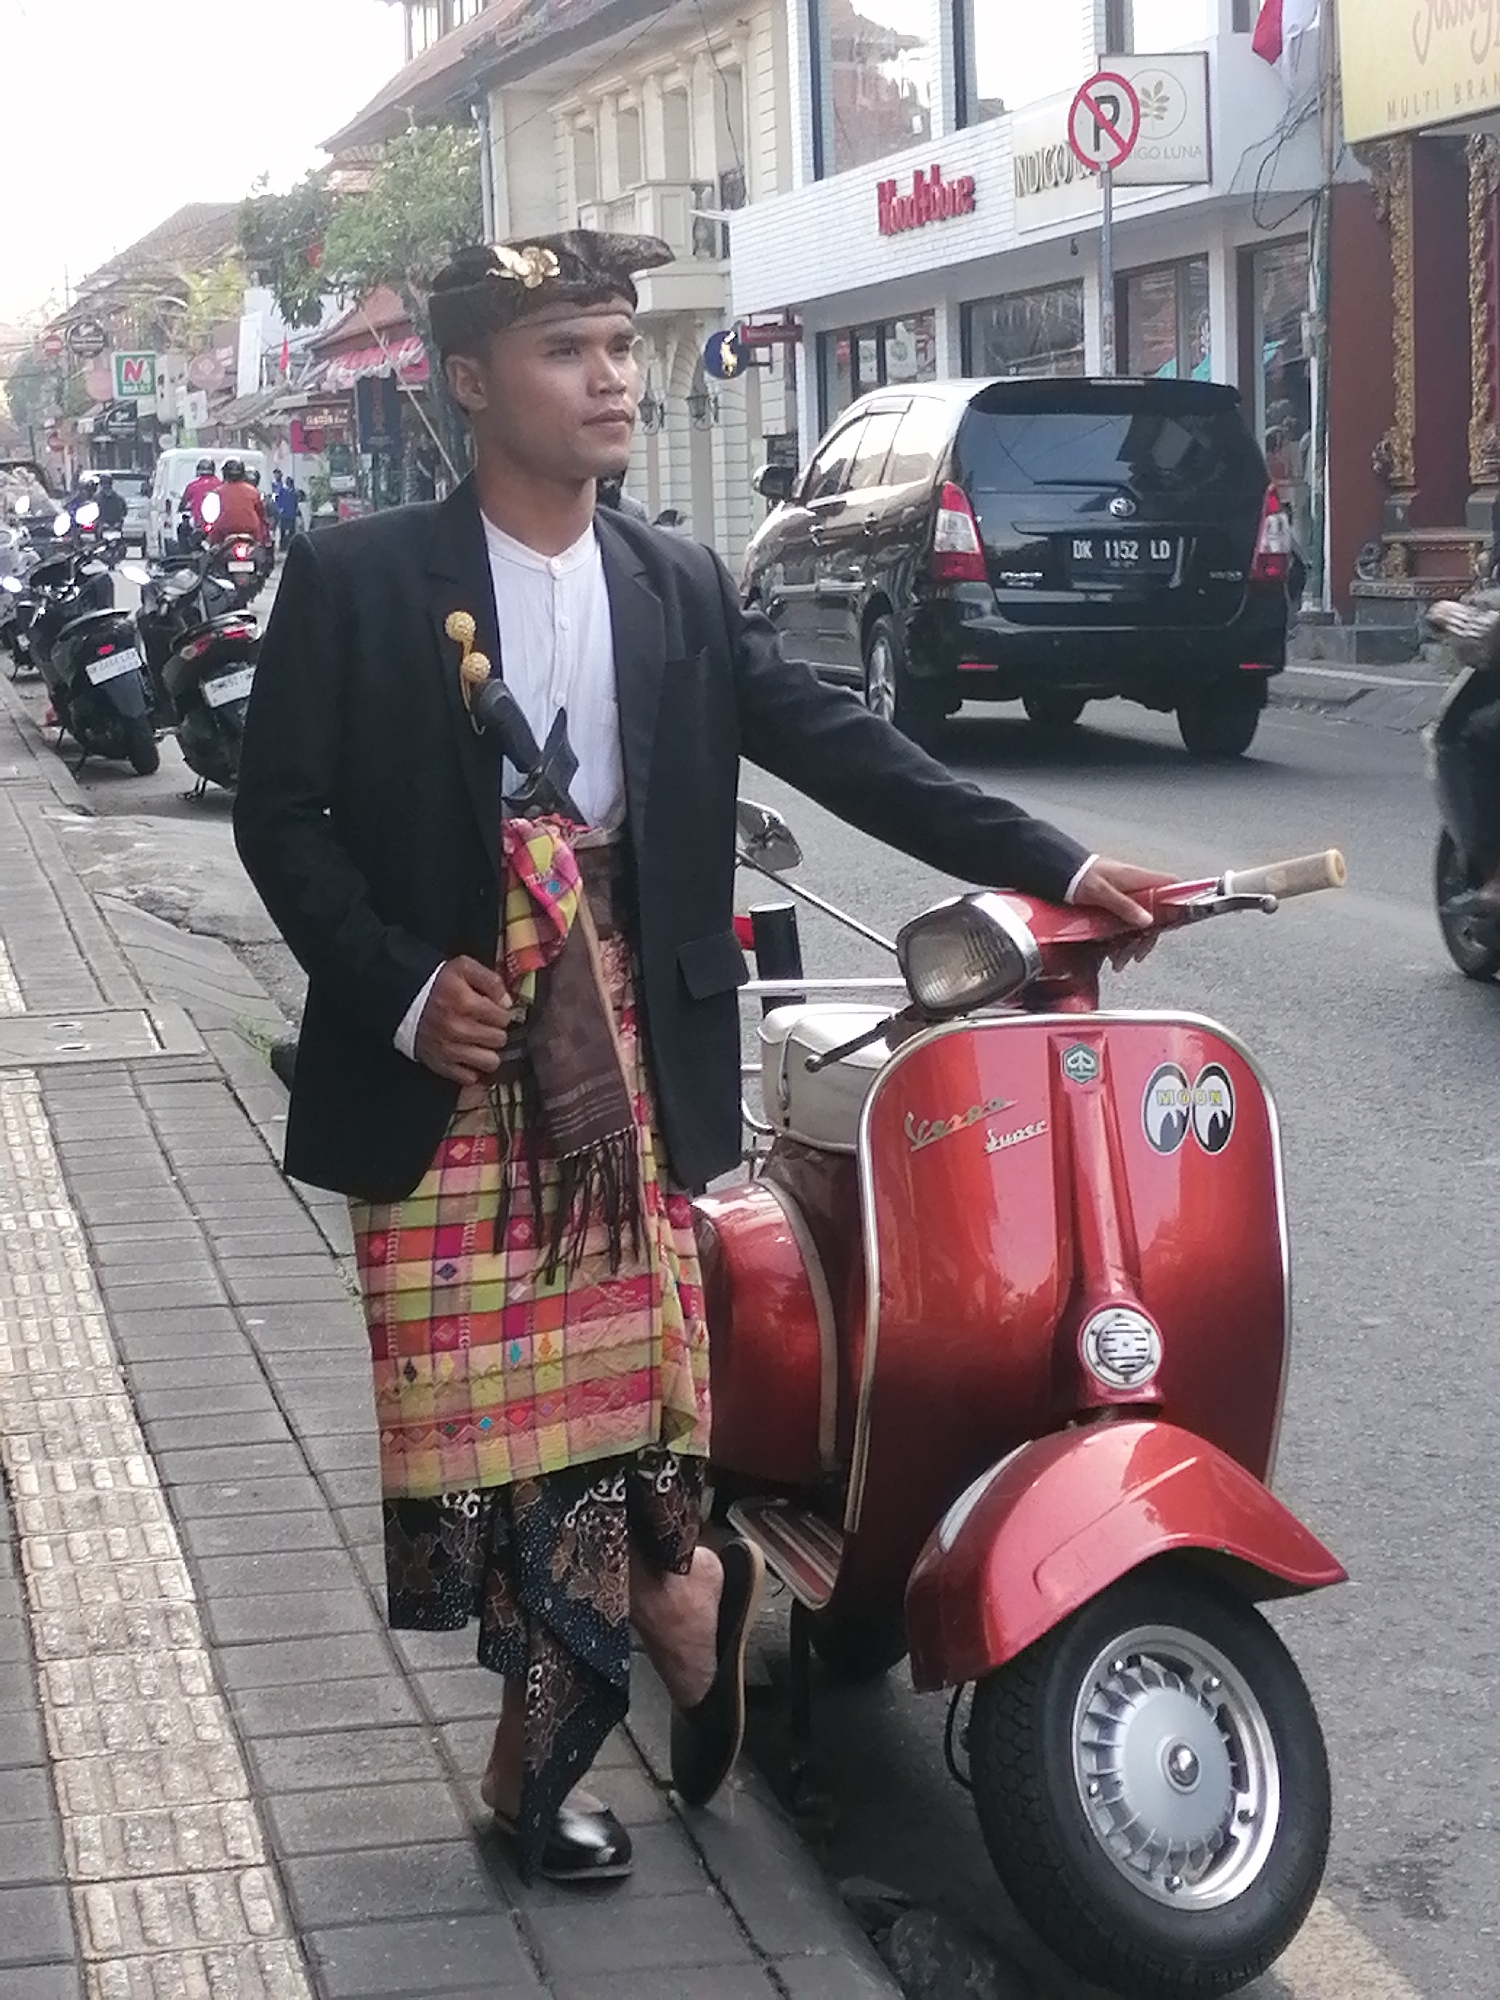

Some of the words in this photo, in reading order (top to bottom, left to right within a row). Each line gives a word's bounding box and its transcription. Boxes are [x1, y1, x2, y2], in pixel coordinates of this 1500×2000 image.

[1387, 88, 1440, 122] MULTI
[1093, 95, 1120, 152] P
[1164, 145, 1202, 160] LUNA
[1072, 539, 1094, 560] DK
[1104, 539, 1140, 560] 1152
[1150, 539, 1171, 560] LD
[1156, 1089, 1223, 1107] MOON
[904, 1098, 1018, 1153] Vespa
[984, 1121, 1049, 1155] Super
